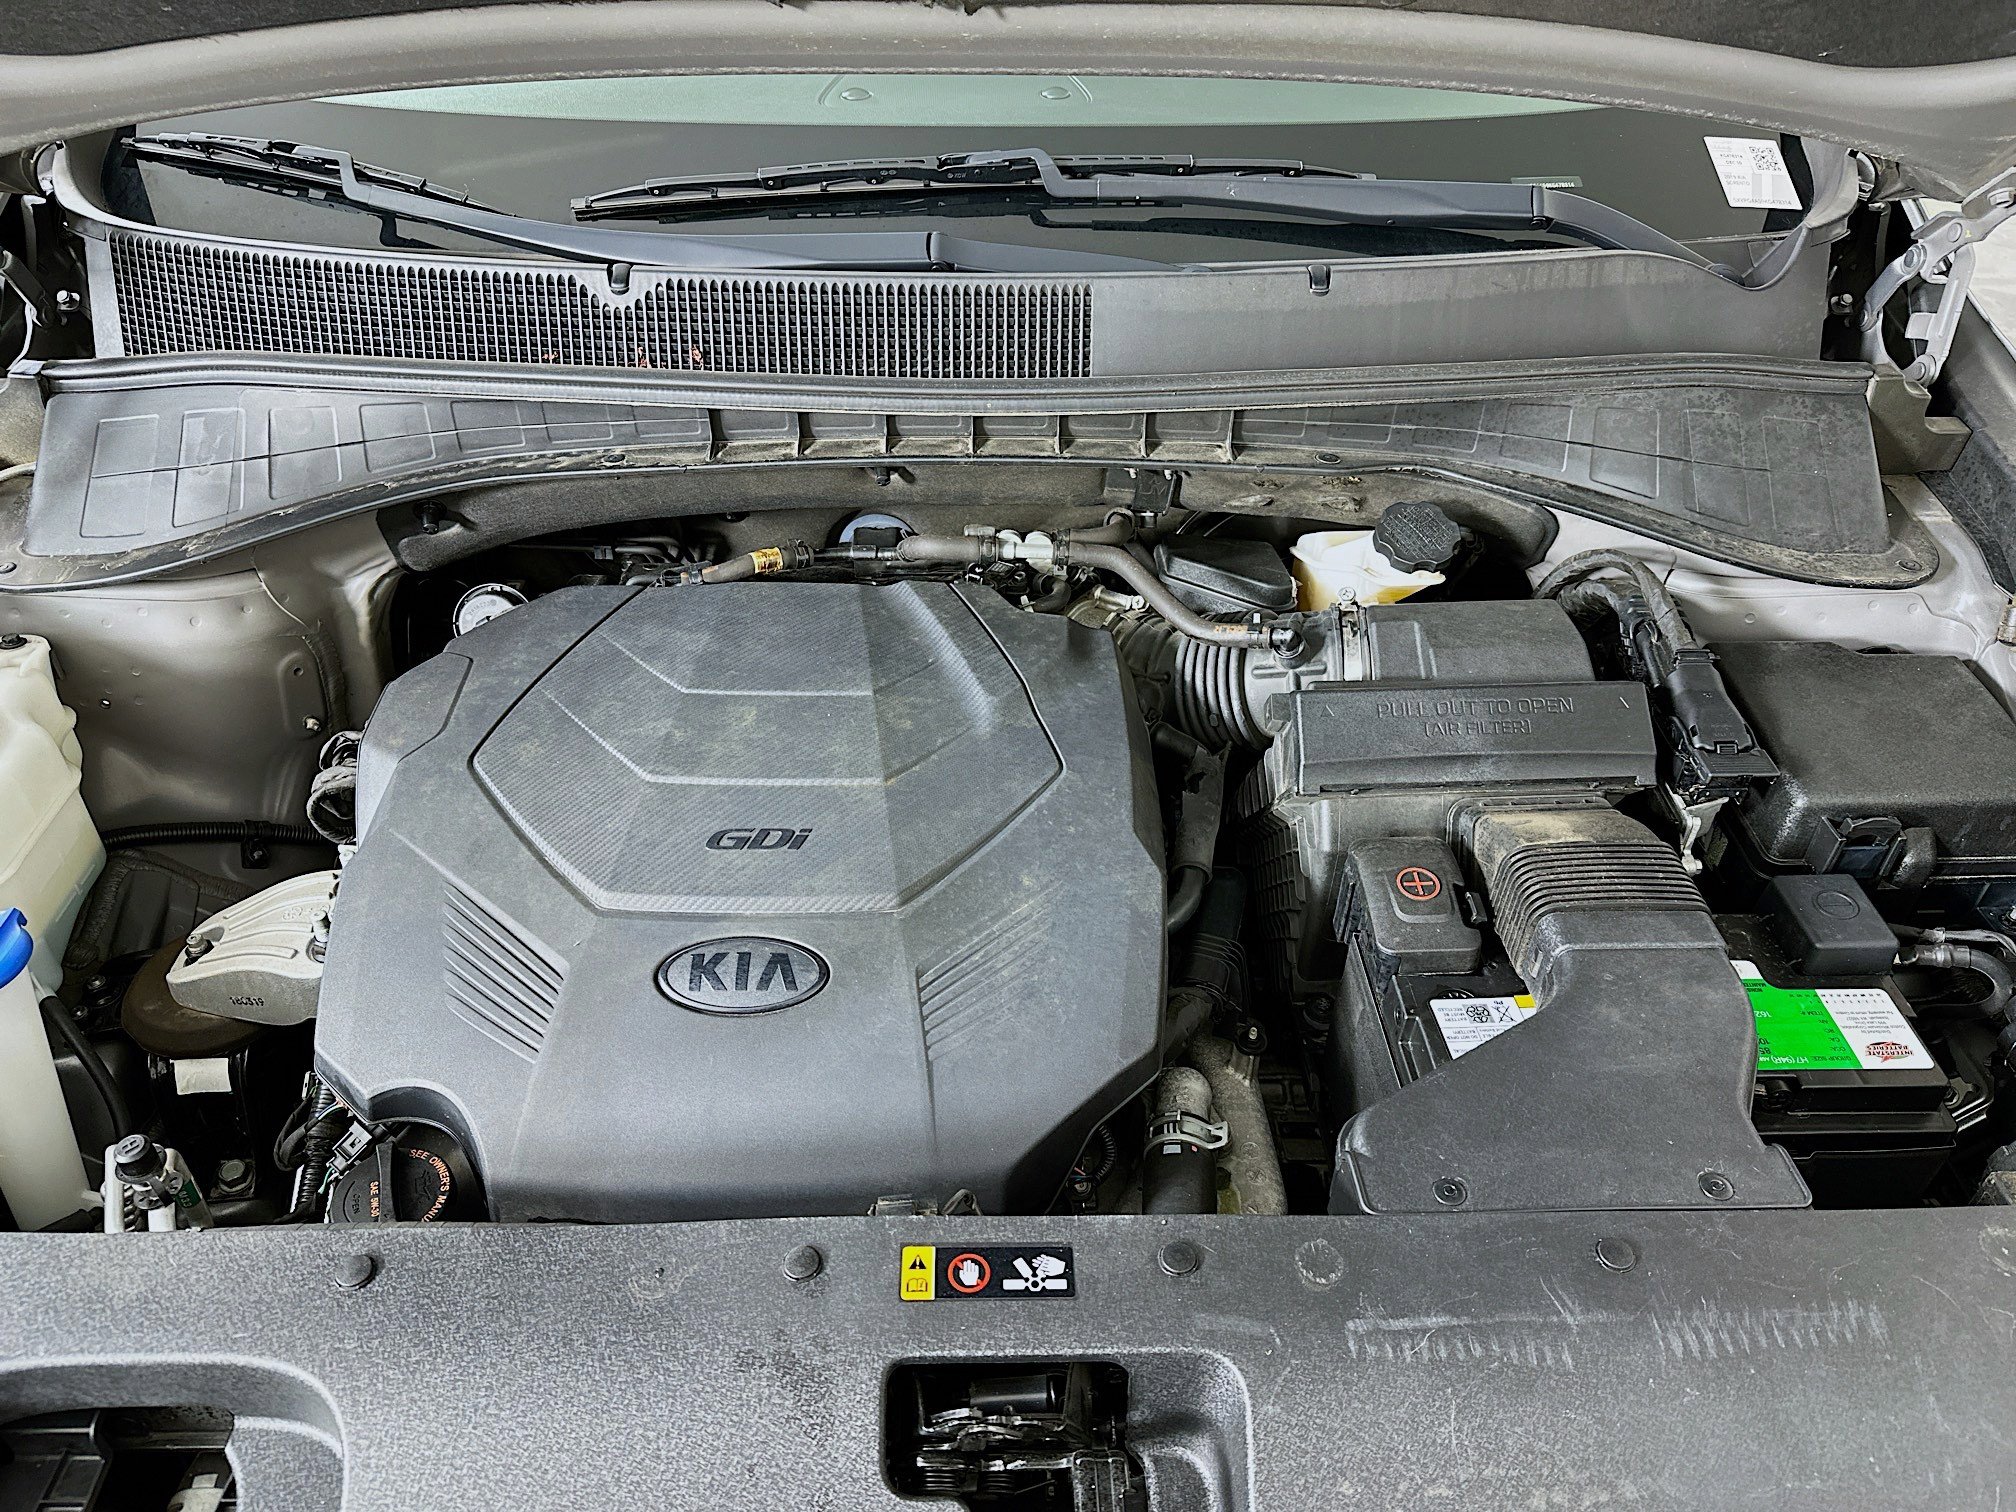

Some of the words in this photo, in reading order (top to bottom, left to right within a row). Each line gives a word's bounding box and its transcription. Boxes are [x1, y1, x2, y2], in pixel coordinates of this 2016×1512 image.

[1377, 701, 1430, 718] PULL
[1436, 700, 1478, 717] OUT
[1483, 698, 1511, 716] TO
[1518, 697, 1574, 715] OPEN
[705, 827, 813, 851] GDi
[688, 951, 799, 992] KIA
[409, 1148, 430, 1160] SEE
[429, 1156, 450, 1192] OWNER'S
[370, 1181, 379, 1196] SAE
[421, 1195, 447, 1222] MANU
